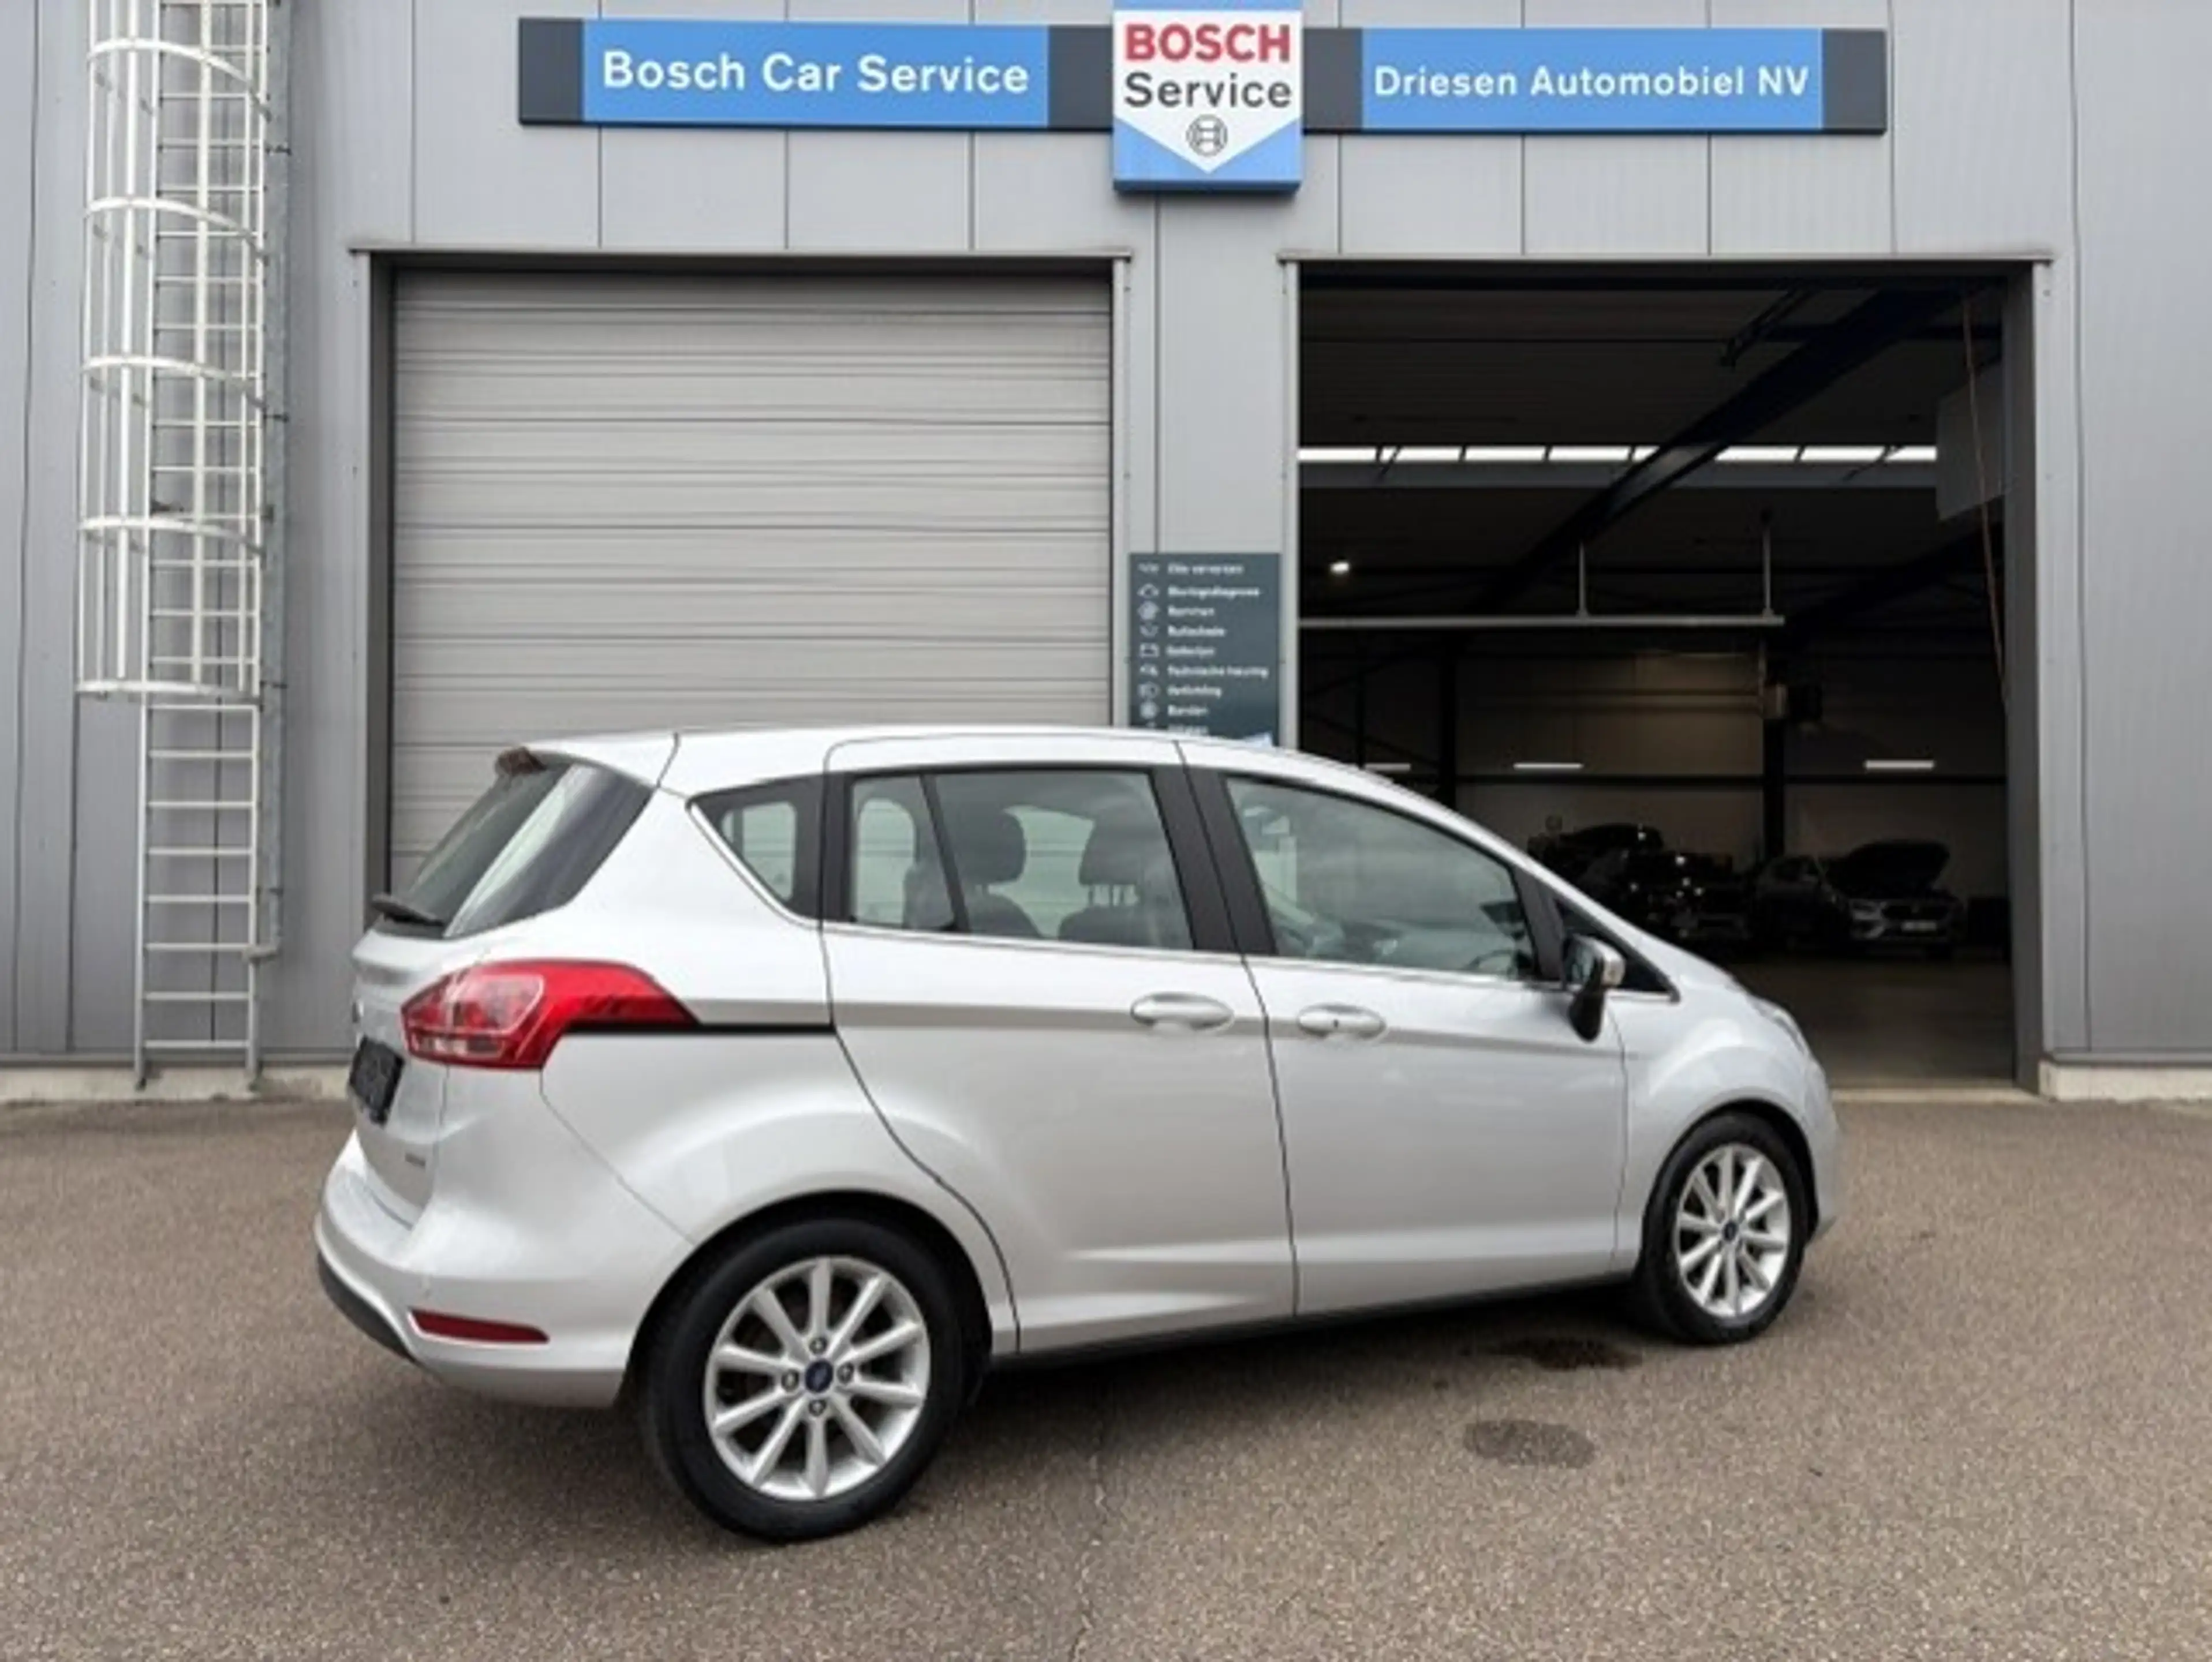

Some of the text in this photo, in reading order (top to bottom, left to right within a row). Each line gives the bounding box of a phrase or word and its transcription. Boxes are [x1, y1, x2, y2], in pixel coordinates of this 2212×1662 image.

[1125, 24, 1290, 62] BOSCH
[604, 51, 1028, 93] Bosch Car Service
[1124, 72, 1292, 108] Service
[1375, 66, 1808, 96] Driesen Automobiel NV
